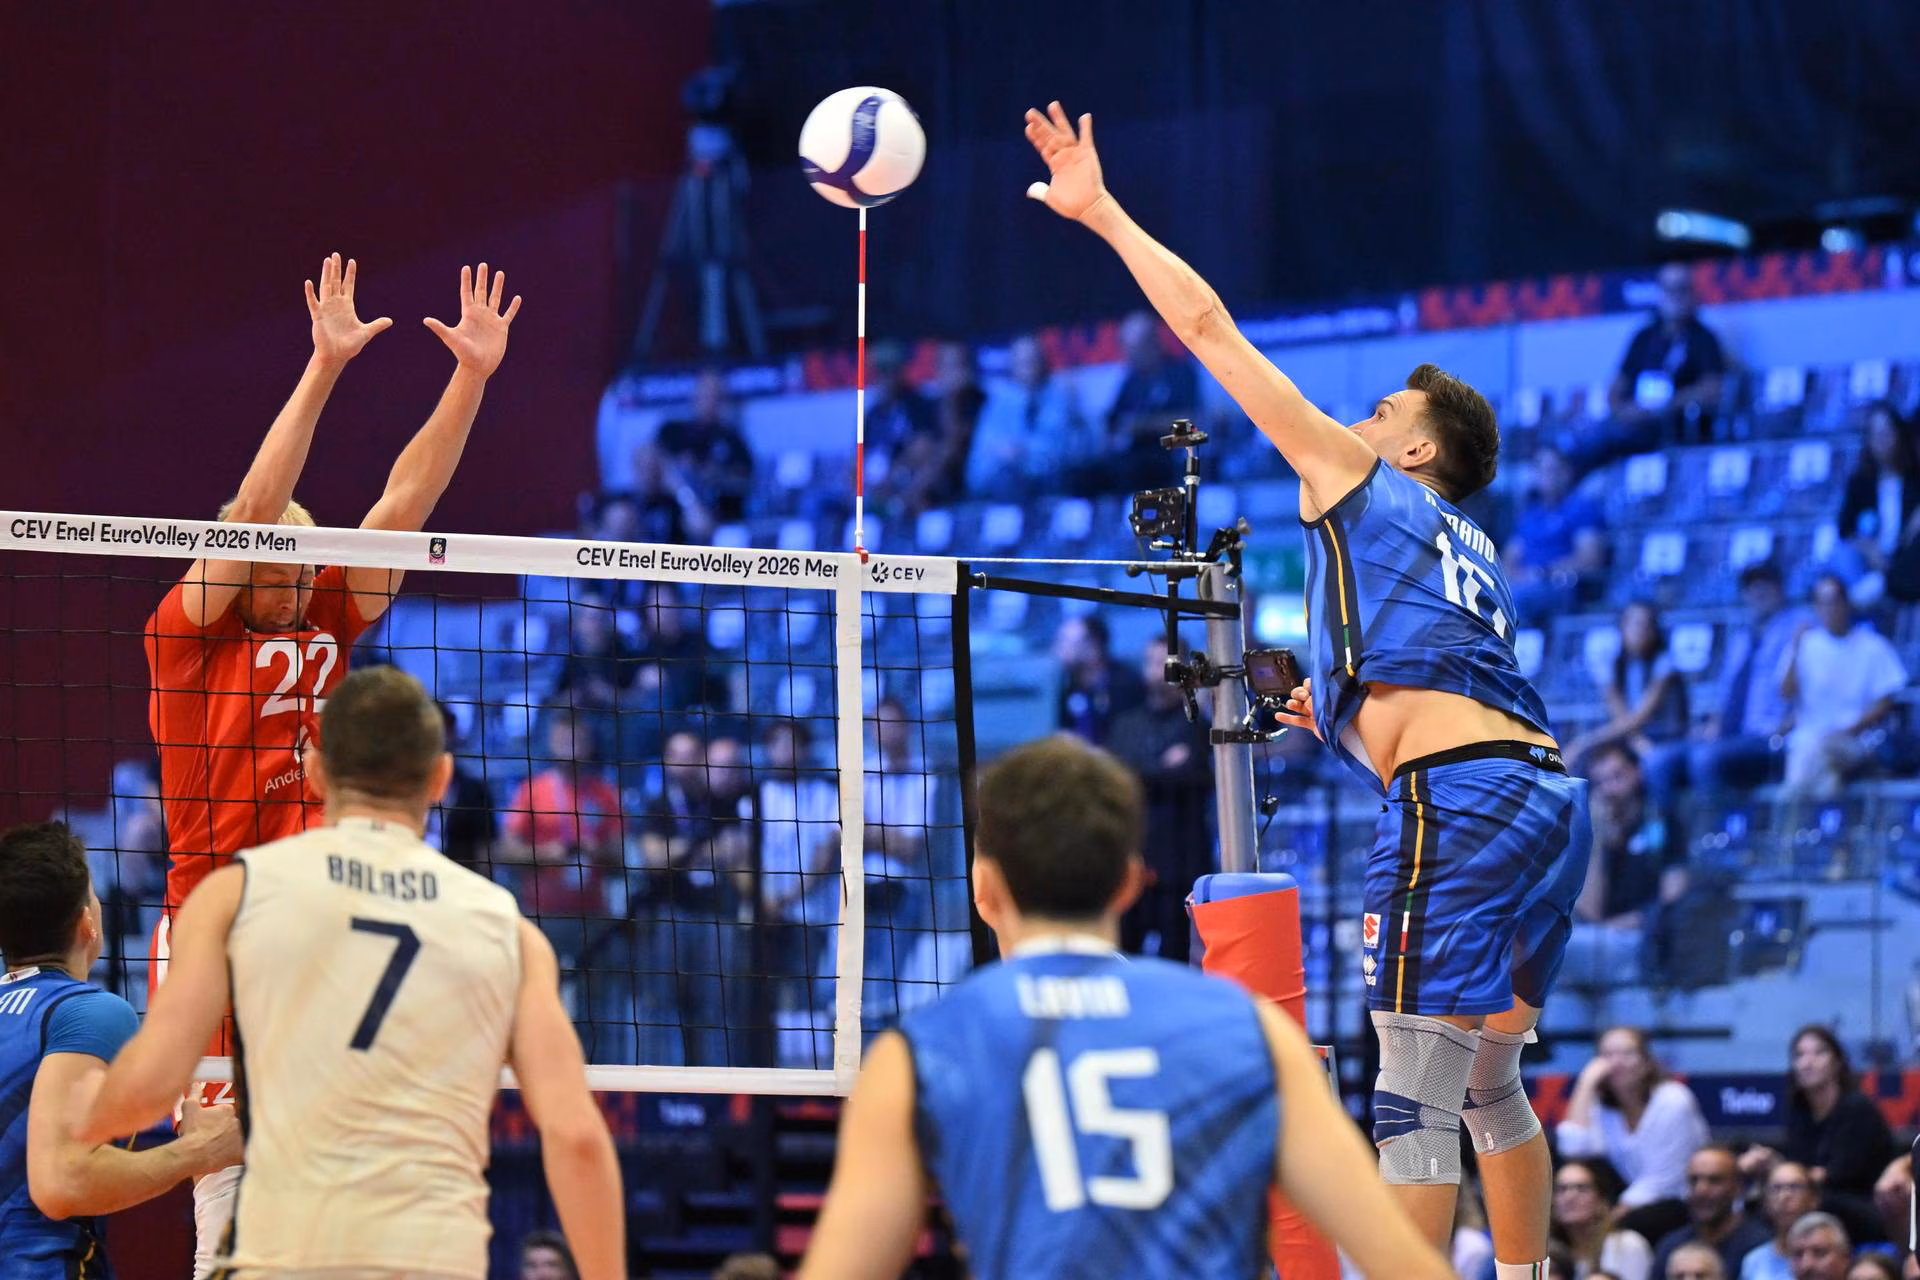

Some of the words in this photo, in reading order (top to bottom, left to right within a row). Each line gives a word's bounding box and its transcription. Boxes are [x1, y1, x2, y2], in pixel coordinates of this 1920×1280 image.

[10, 518, 52, 539] CEV
[56, 521, 96, 541] Enel
[100, 523, 200, 551] EuroVolley
[204, 528, 251, 549] 2026
[255, 531, 297, 551] Men
[576, 547, 615, 566] CEV
[619, 549, 656, 569] Enel
[661, 551, 753, 578] EuroVolley
[757, 555, 800, 576] 2026
[893, 567, 925, 580] CEV
[256, 633, 338, 719] 22
[327, 854, 437, 901] BALASO
[348, 916, 421, 1052] 7
[1022, 1047, 1175, 1212] 15
